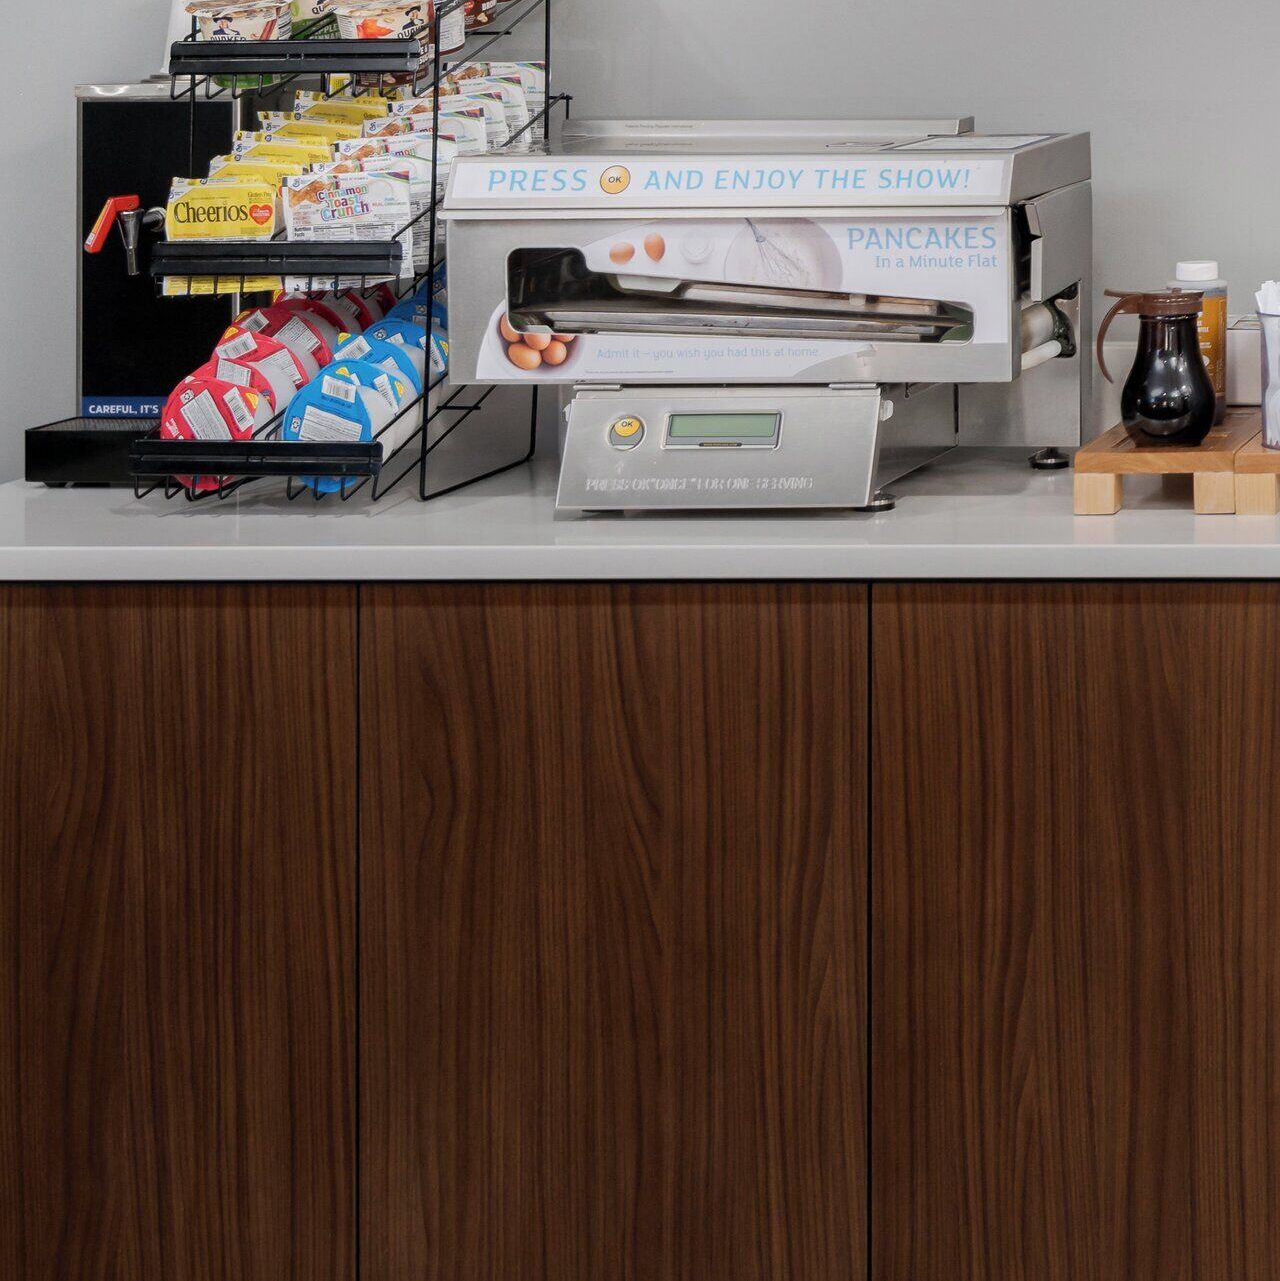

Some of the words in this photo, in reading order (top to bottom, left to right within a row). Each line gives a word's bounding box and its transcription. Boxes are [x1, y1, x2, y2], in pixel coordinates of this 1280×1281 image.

[488, 169, 587, 192] PRESS
[608, 176, 622, 184] OK
[644, 170, 703, 190] AND
[714, 169, 804, 190] ENJOY
[815, 169, 867, 189] THE
[878, 169, 970, 189] SHOW!
[317, 185, 368, 200] Cinnamon
[326, 194, 360, 209] Toast
[174, 201, 248, 223] Cheerios
[321, 201, 370, 221] Crunch
[847, 226, 996, 250] PANCAKES
[875, 255, 891, 269] In
[896, 258, 905, 268] a
[909, 255, 963, 268] Minute
[968, 254, 997, 268] Flat
[597, 348, 630, 359] Admit
[633, 348, 640, 359] it
[653, 350, 673, 362] you
[676, 347, 700, 359] wish
[704, 350, 724, 362] you
[727, 347, 747, 358] had
[751, 346, 771, 357] this
[774, 348, 785, 357] at
[89, 405, 137, 415] CAREFUL,
[140, 405, 159, 414] IT'S
